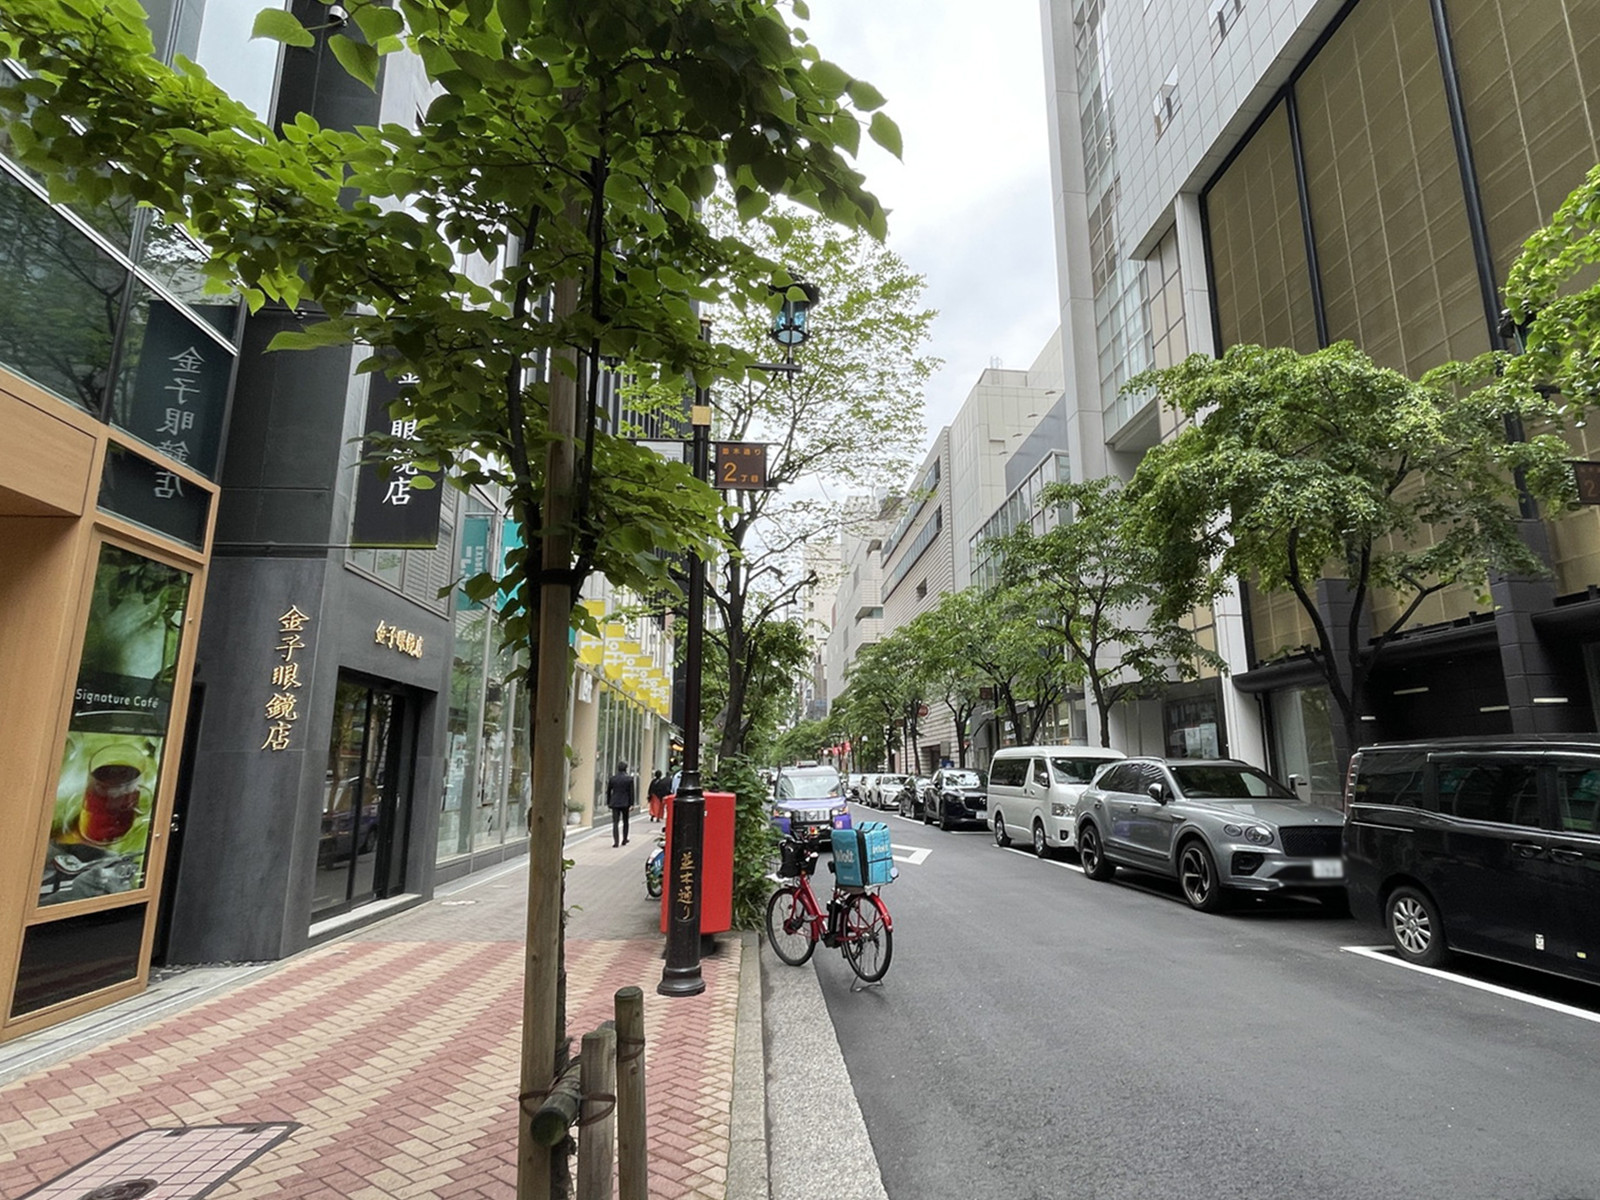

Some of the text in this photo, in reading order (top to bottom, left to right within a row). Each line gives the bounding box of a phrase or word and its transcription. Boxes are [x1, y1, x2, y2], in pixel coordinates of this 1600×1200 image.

[75, 688, 160, 709] Signature Café
[261, 604, 310, 751] 金子眼鏡店
